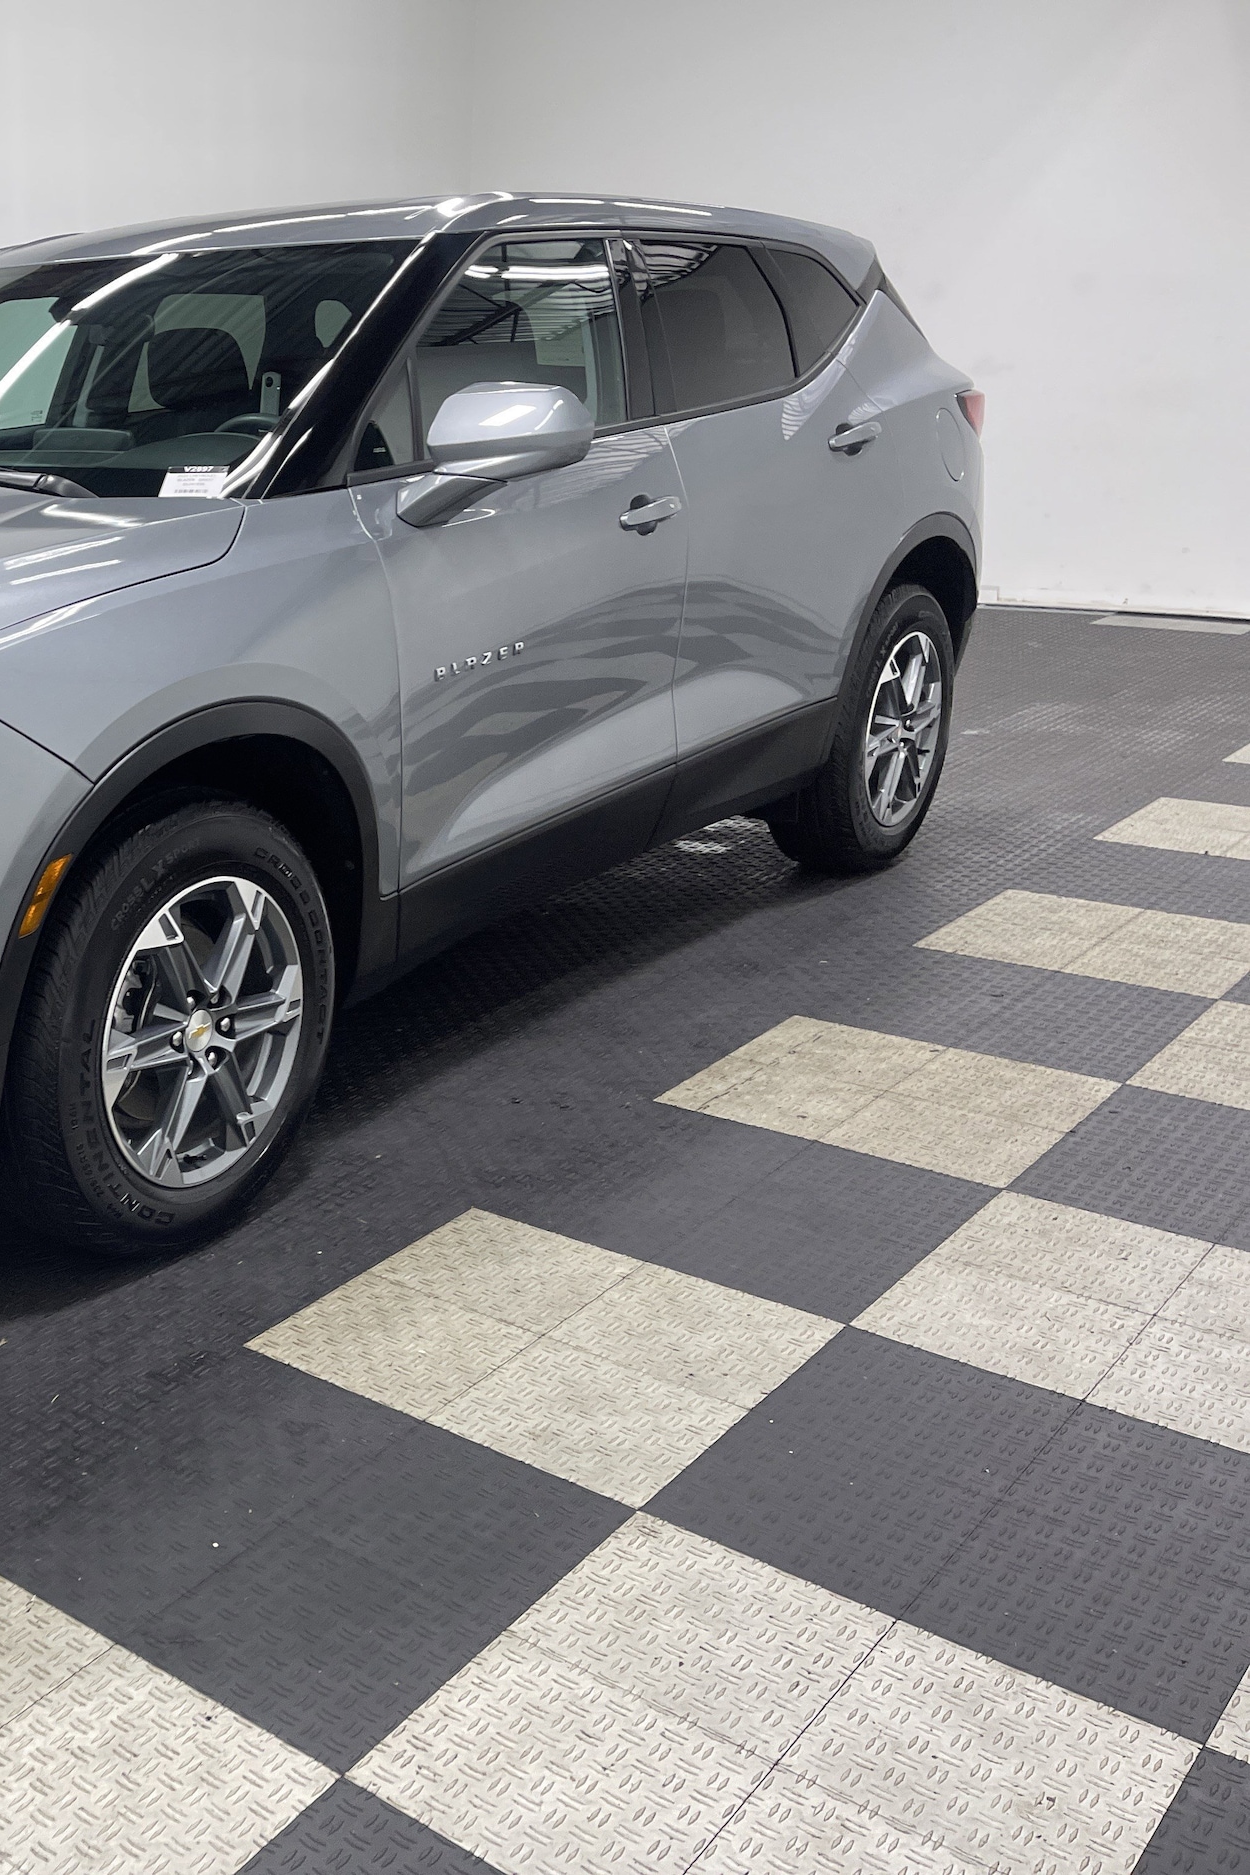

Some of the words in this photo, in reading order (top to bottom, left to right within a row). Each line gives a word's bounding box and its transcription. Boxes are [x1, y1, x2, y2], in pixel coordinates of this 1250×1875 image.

[434, 641, 524, 681] BLAZER
[140, 859, 167, 892] LX
[79, 1019, 176, 1226] CONTINENTAL
